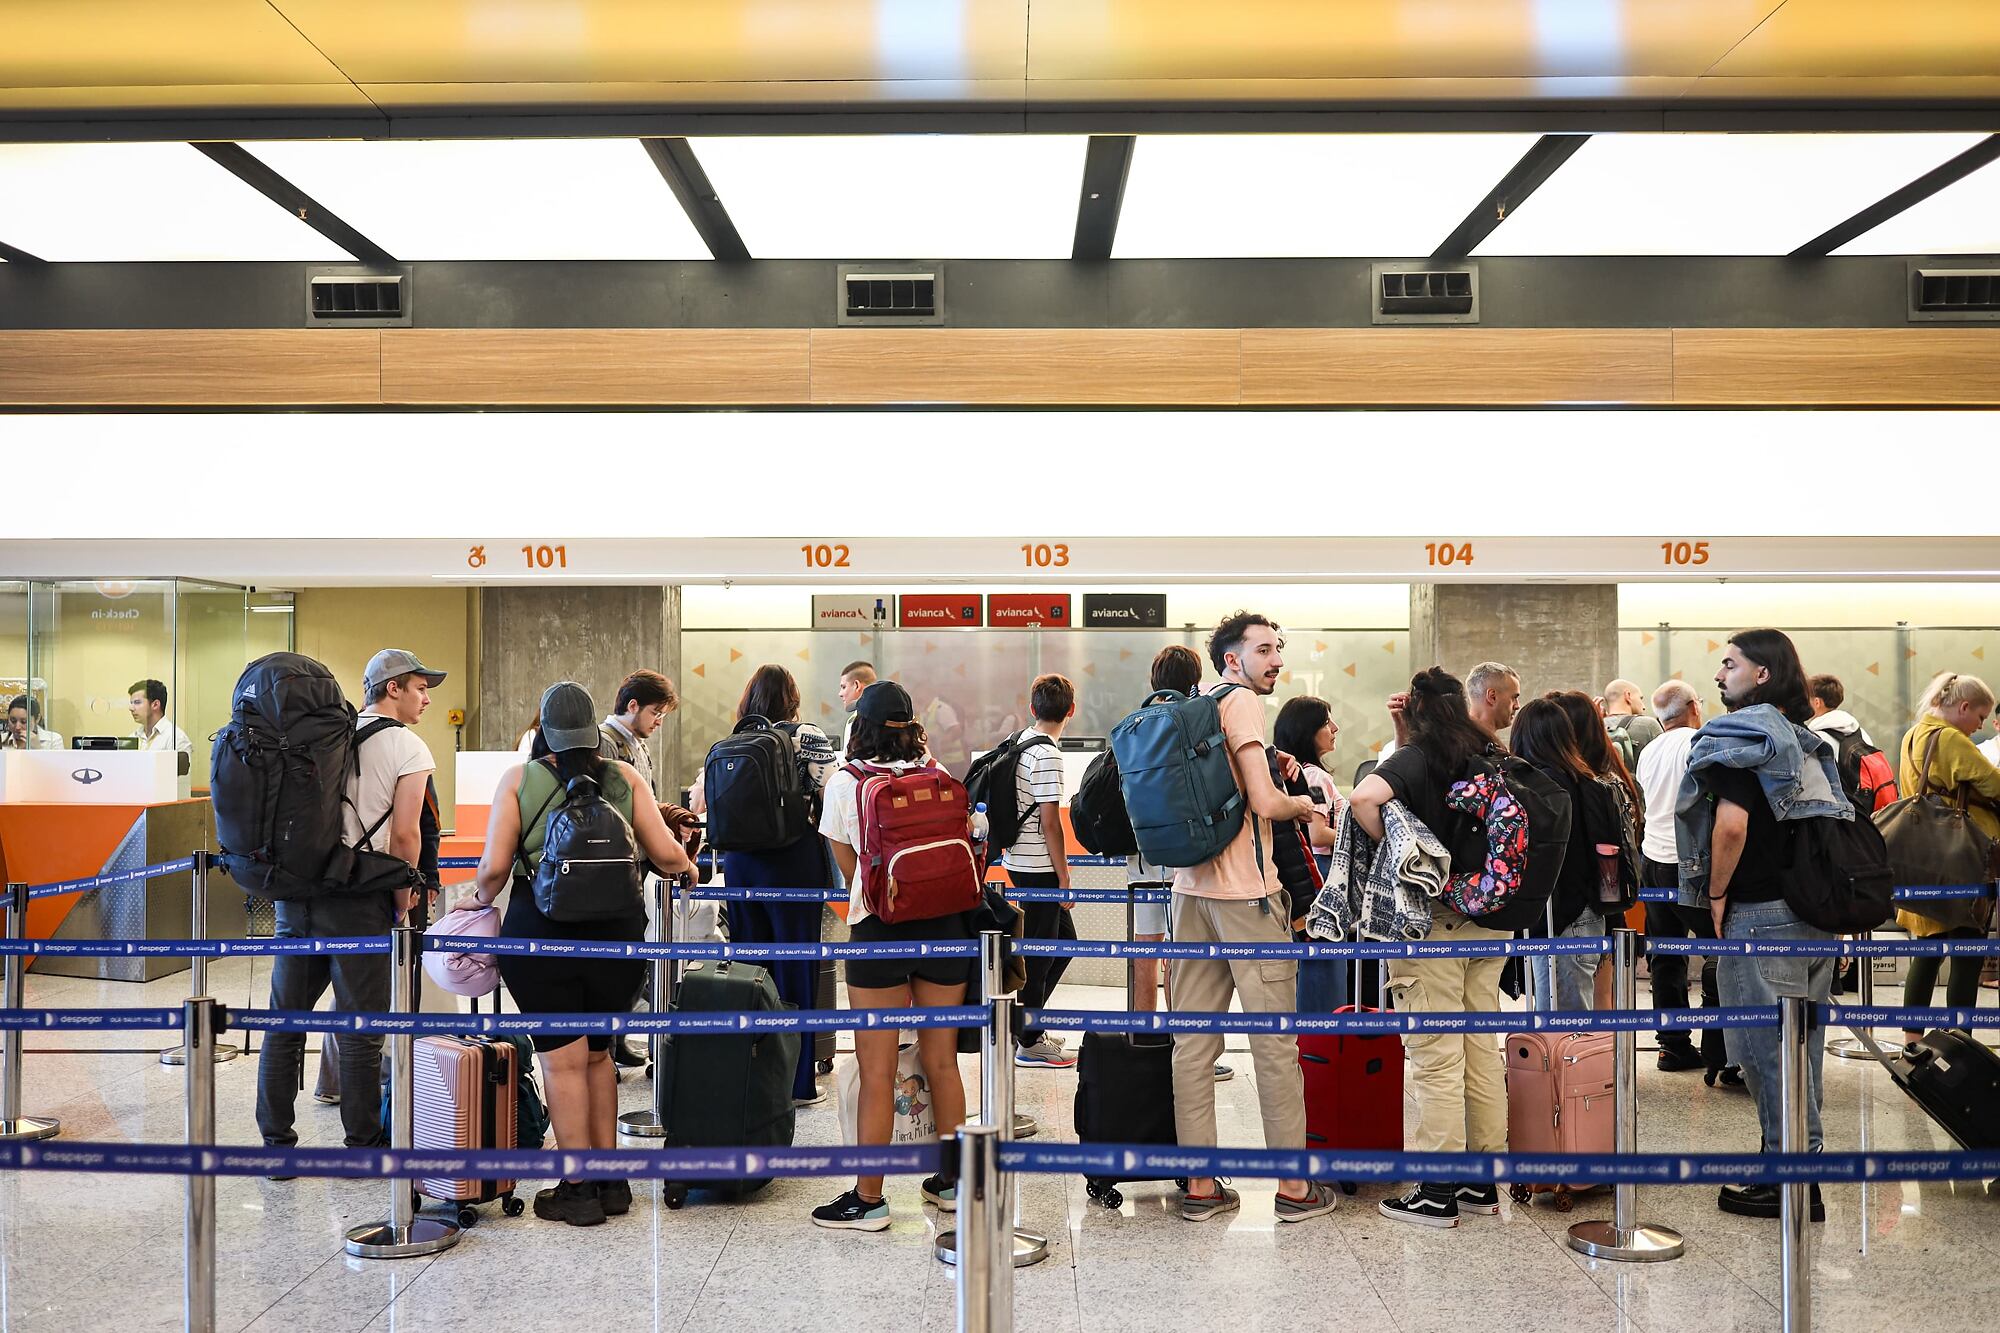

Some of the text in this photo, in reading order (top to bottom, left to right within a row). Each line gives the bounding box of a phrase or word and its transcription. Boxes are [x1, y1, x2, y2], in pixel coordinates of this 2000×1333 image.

[521, 545, 566, 568] 101
[801, 544, 850, 567] 102
[1021, 544, 1069, 567] 103
[1425, 543, 1473, 566] 104
[1661, 542, 1709, 564] 105
[821, 609, 856, 618] avianca
[908, 608, 944, 617] avianca
[996, 608, 1033, 617] avianca
[1092, 608, 1129, 617] avianca
[45, 945, 77, 953] despegar
[445, 941, 478, 949] despegar
[542, 945, 575, 953] despegar
[638, 947, 671, 955] despegar
[834, 948, 867, 956] despegar
[1023, 944, 1057, 953] despegar
[1123, 947, 1156, 955] despegar
[1222, 948, 1255, 956] despegar
[1321, 948, 1354, 956] despegar
[1757, 945, 1790, 953] despegar
[1955, 945, 1988, 953] despegar
[60, 1016, 103, 1024] despegar
[241, 1016, 285, 1025] despegar
[370, 1019, 414, 1028] despegar
[499, 1021, 542, 1029] despegar
[627, 1020, 671, 1028] despegar
[755, 1018, 798, 1026] despegar
[883, 1015, 926, 1023] despegar
[1040, 1016, 1083, 1025] despegar
[1168, 1019, 1211, 1028] despegar
[1296, 1020, 1338, 1028] despegar
[1423, 1019, 1466, 1028] despegar
[1550, 1018, 1592, 1026] despegar
[1676, 1015, 1718, 1023] despegar
[1845, 1012, 1887, 1021] despegar
[1972, 1015, 2000, 1023] despe
[915, 1126, 923, 1139] Mi
